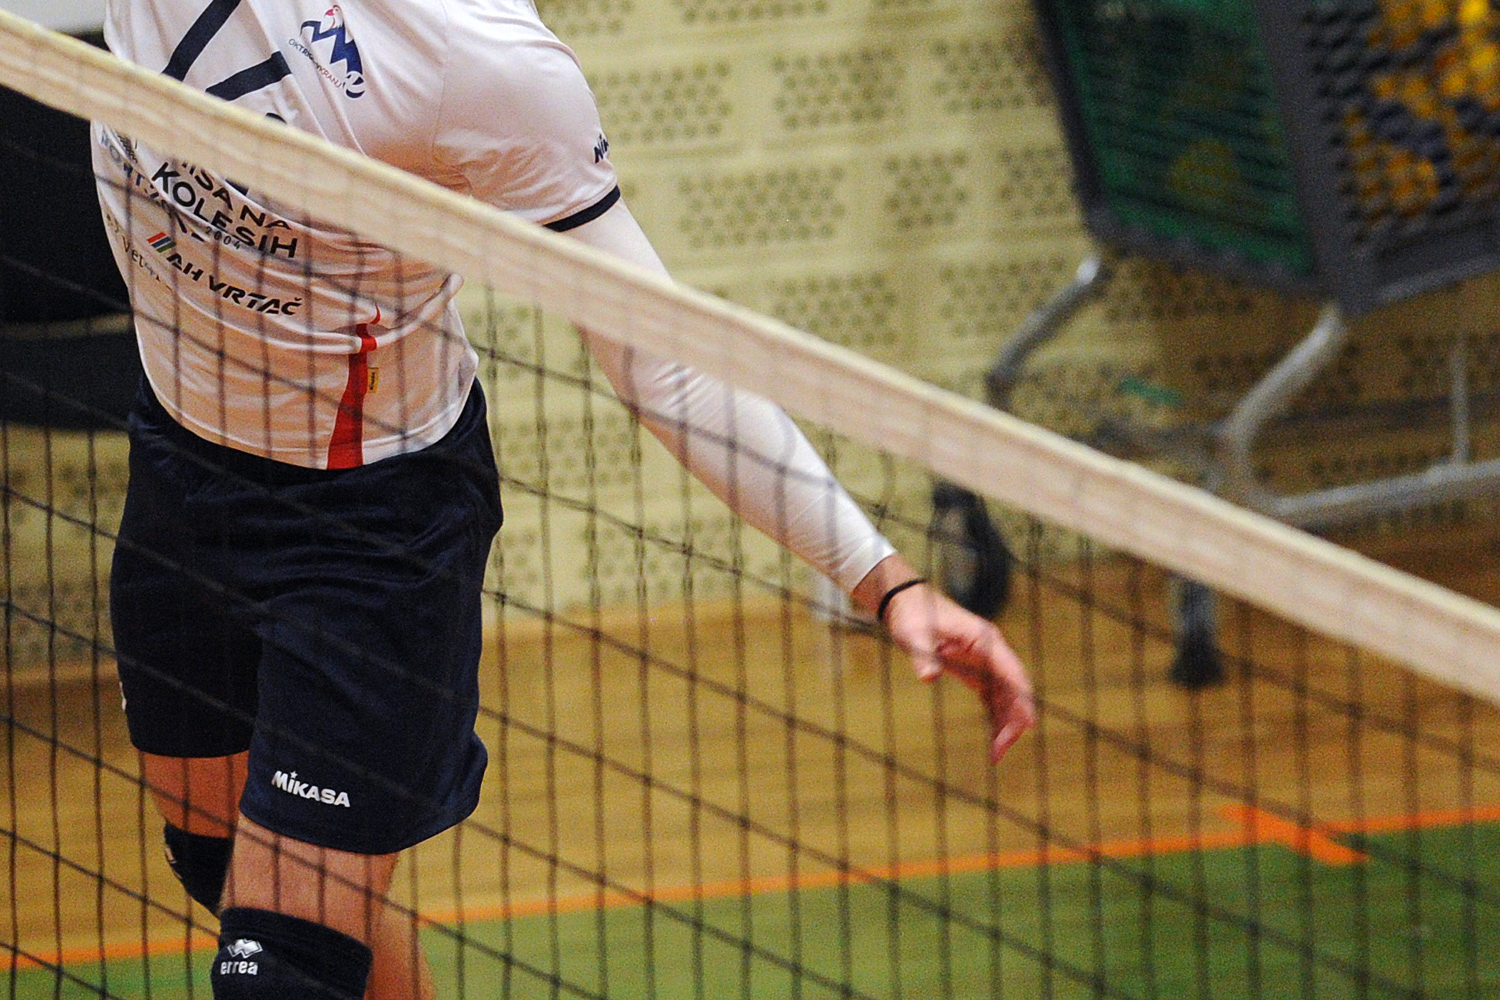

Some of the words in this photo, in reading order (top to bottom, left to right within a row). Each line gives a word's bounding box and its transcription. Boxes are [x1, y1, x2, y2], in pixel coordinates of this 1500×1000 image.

[151, 161, 299, 259] KOLESIH
[165, 252, 205, 282] AH
[208, 274, 303, 316] VRTAČ
[219, 958, 259, 976] errea
